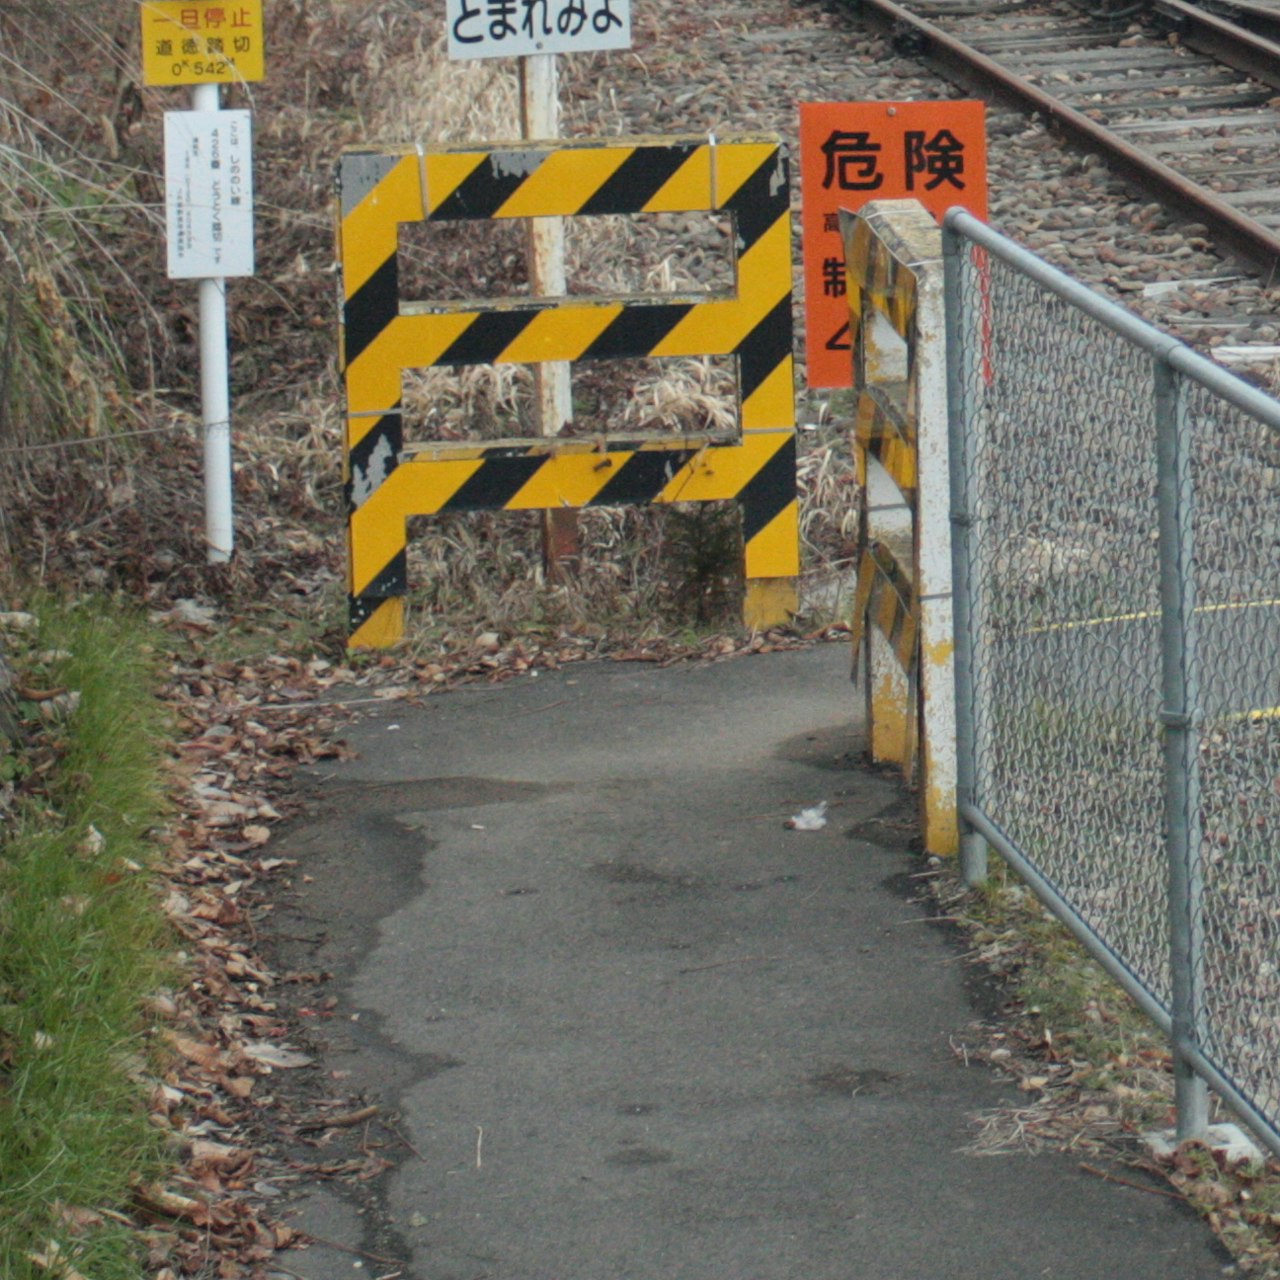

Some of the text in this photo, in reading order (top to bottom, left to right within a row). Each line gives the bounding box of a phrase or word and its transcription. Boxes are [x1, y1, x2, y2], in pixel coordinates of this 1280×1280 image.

[153, 7, 252, 30] 一旦停止
[820, 128, 966, 191] 危険
